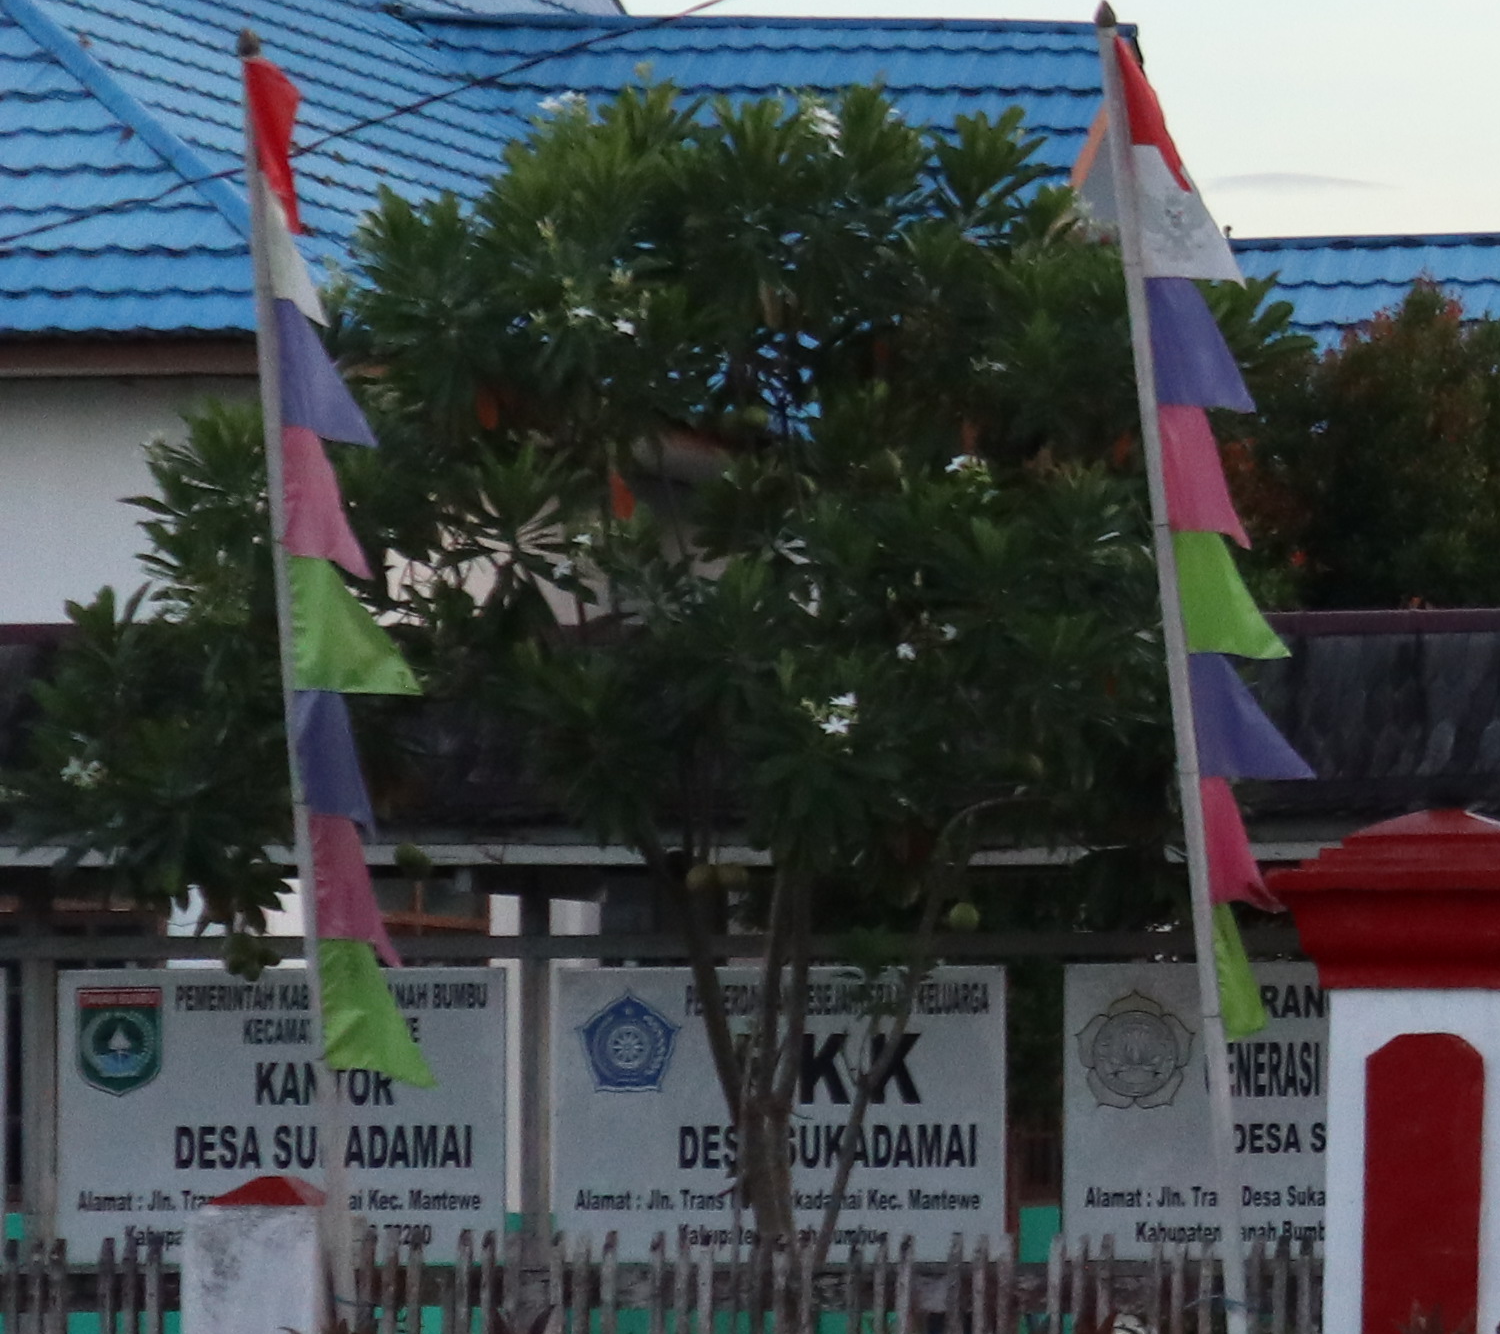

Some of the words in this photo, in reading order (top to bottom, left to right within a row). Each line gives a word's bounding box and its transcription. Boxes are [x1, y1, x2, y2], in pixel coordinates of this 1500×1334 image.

[175, 984, 275, 1011] PEMERINTAH
[387, 982, 428, 1009] NAH
[433, 982, 488, 1009] BUMBU
[918, 984, 989, 1014] KELUARGA
[1261, 985, 1329, 1018] RAN
[243, 1018, 313, 1044] KECAMA
[768, 1034, 921, 1104] KK
[1204, 1041, 1321, 1098] ENERASI
[174, 1126, 262, 1169] DESA
[273, 1125, 473, 1169] SUADAMAI
[679, 1125, 738, 1169] DES
[1233, 1122, 1301, 1154] DESA
[77, 1190, 133, 1211] Alamat
[147, 1190, 176, 1211] Jln.
[181, 1190, 215, 1211] Tra
[368, 1190, 403, 1211] Kec.
[409, 1190, 482, 1211] Mantewe
[576, 1189, 632, 1210] Alamat
[647, 1189, 675, 1210] Jln.
[680, 1189, 724, 1210] Trans
[794, 1188, 862, 1210] kadaai
[868, 1189, 903, 1210] Kec.
[909, 1188, 981, 1210] Mantewe
[1085, 1186, 1142, 1208] Alamat
[1157, 1186, 1186, 1208] Jln.
[1191, 1185, 1218, 1208] Tra
[1242, 1184, 1281, 1207] Desa
[1241, 1221, 1277, 1242] anah
[1282, 1220, 1326, 1242] Bumb
